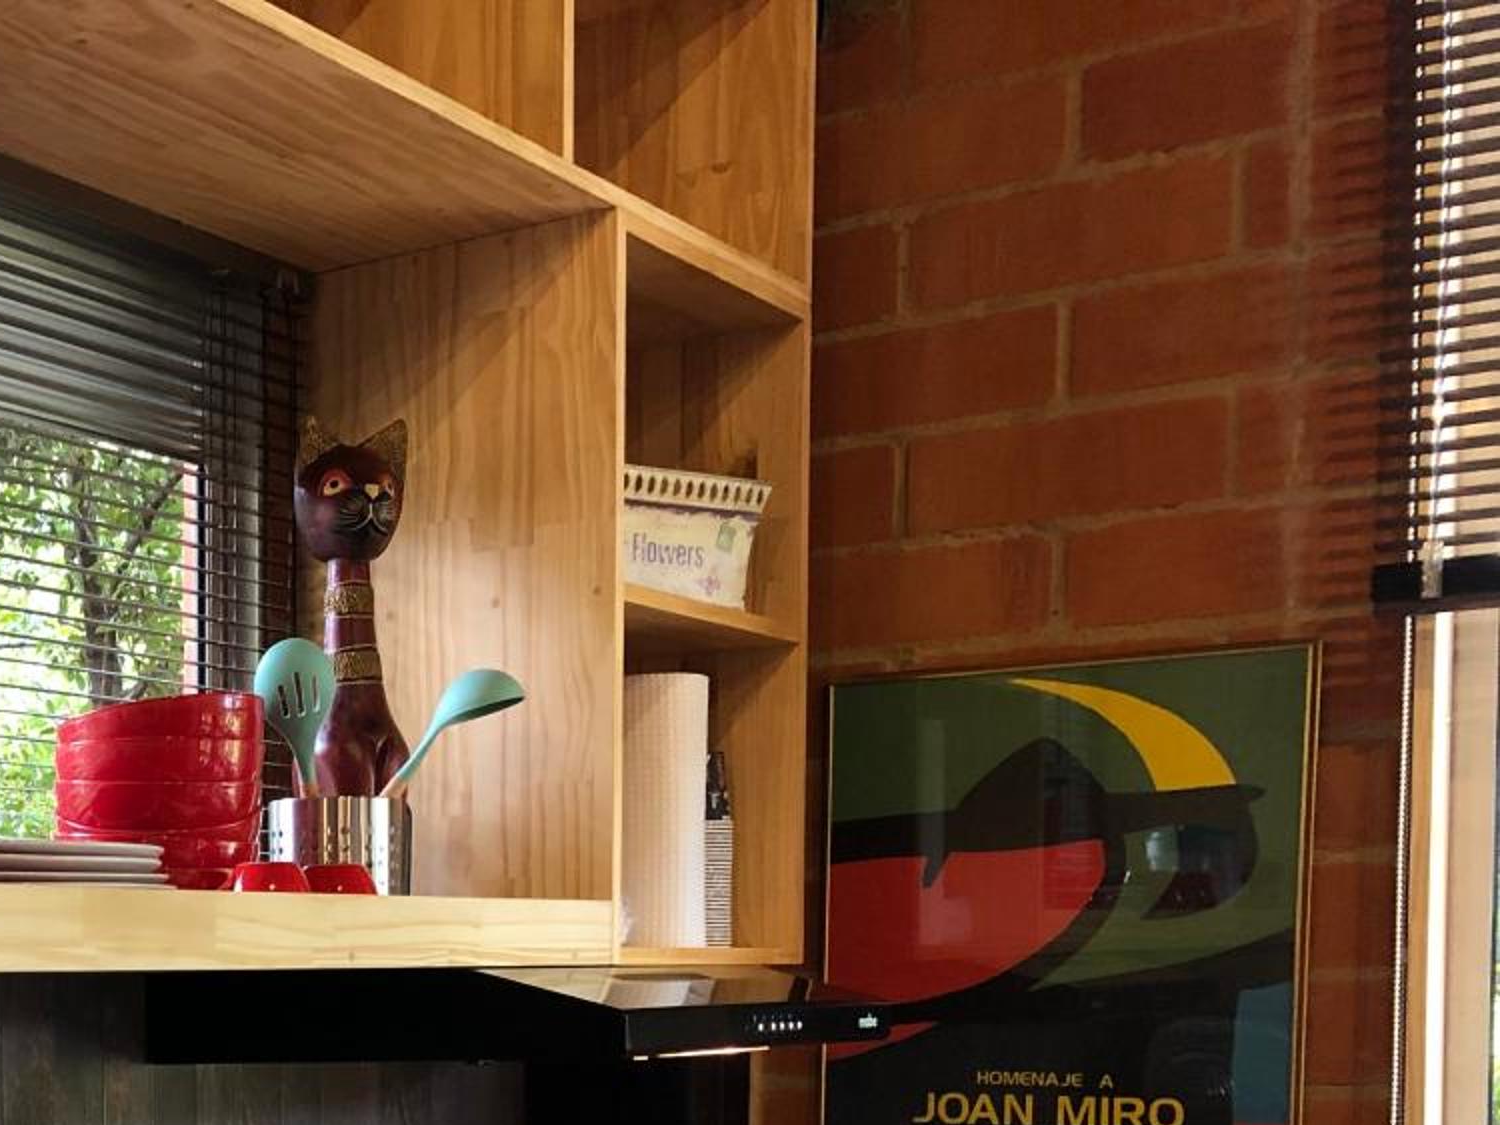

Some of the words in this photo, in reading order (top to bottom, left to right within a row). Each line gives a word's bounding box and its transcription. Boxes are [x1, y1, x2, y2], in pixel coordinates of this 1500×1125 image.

[632, 531, 706, 568] Flowers
[976, 1070, 1084, 1087] HOMENAJE
[1099, 1073, 1114, 1089] A
